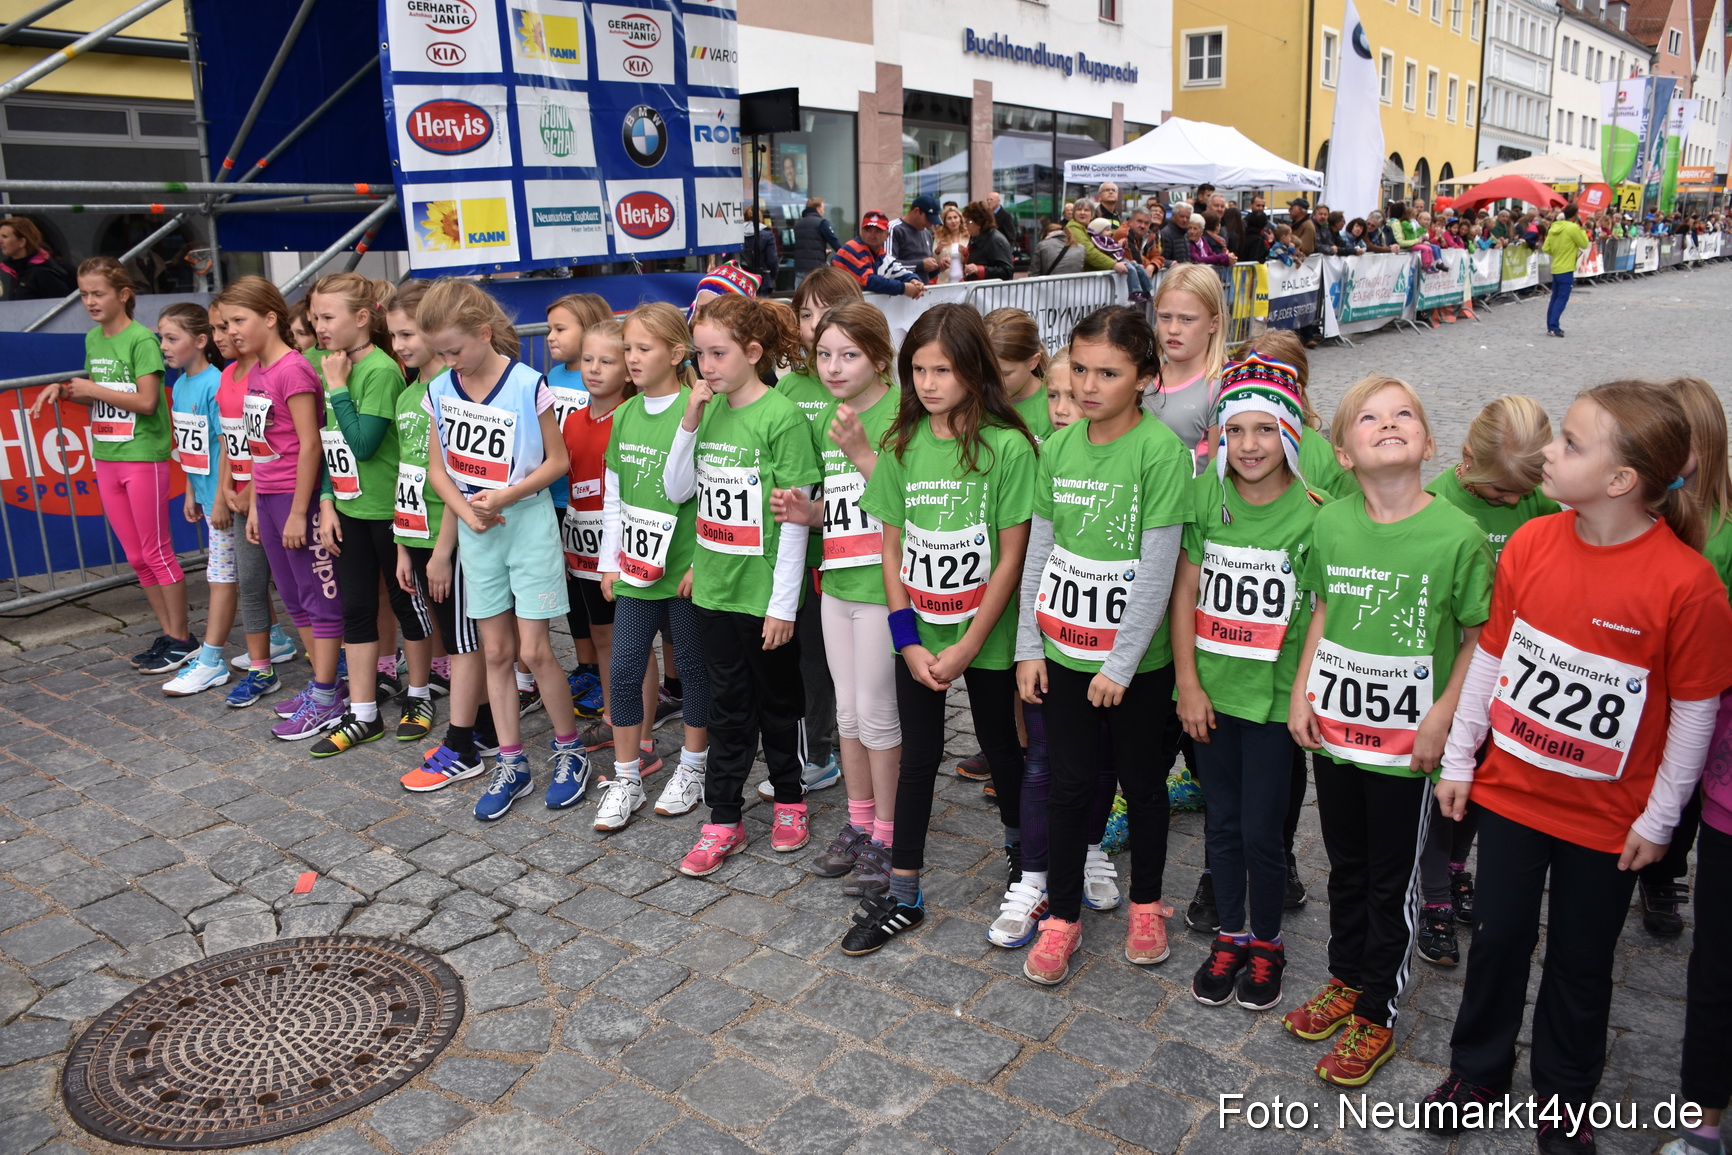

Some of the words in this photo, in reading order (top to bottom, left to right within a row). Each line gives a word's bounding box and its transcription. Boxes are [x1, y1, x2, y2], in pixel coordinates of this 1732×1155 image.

[408, 1, 461, 14] GERHART
[432, 15, 470, 25] JANIG
[608, 20, 651, 32] GERHART
[629, 31, 656, 41] JANIG
[432, 48, 459, 60] KIA
[550, 47, 576, 59] KANN
[709, 48, 738, 63] VARIO
[963, 27, 1073, 77] Buchhandlung
[1078, 51, 1138, 83] Rupprecht
[628, 60, 648, 72] KIA
[541, 96, 569, 127] RUND
[626, 107, 662, 127] BMW
[416, 112, 486, 141] Hervis
[543, 129, 577, 155] SCHAU
[1092, 164, 1147, 172] ConnectedDrive
[1626, 193, 1636, 204] A
[536, 211, 572, 223] Neumarkter
[572, 210, 599, 222] Tagblatt
[620, 203, 670, 228] Hervis
[468, 231, 505, 244] KANN
[441, 404, 461, 416] PARTL
[463, 410, 500, 424] Neumarkt
[98, 424, 113, 433] Lucia
[445, 417, 506, 458] 7026
[327, 449, 349, 473] 46
[451, 456, 487, 476] Theresa
[397, 482, 419, 511] 44
[698, 481, 748, 521] 7131
[627, 514, 659, 528] Neumarkt
[823, 497, 869, 533] 441
[1128, 484, 1138, 550] BAMBINI
[564, 523, 603, 554] 709
[622, 520, 663, 560] 7187
[703, 523, 734, 542] Sophia
[922, 540, 970, 550] Neumarkt
[907, 547, 980, 589] 7122
[1049, 554, 1067, 574] PARTL
[1068, 564, 1119, 582] Neumarkt
[1221, 556, 1276, 572] Neumarkt
[920, 595, 963, 611] Leonie
[1048, 572, 1127, 624] 7016
[1203, 567, 1286, 618] 7069
[1416, 574, 1429, 649] BAMBINI
[1059, 626, 1098, 647] Alicia
[1592, 618, 1601, 626] FC
[1602, 621, 1641, 635] Holzheim
[1316, 649, 1345, 670] PARTL
[1347, 661, 1408, 679] Neumarkt
[1512, 631, 1546, 661] PARTL
[1549, 652, 1620, 687] Neumarkt
[1319, 669, 1420, 724] 7054
[1510, 654, 1626, 740] 7228
[1345, 727, 1381, 748] Lara
[1509, 717, 1585, 762] Mariella
[1614, 740, 1621, 748] K
